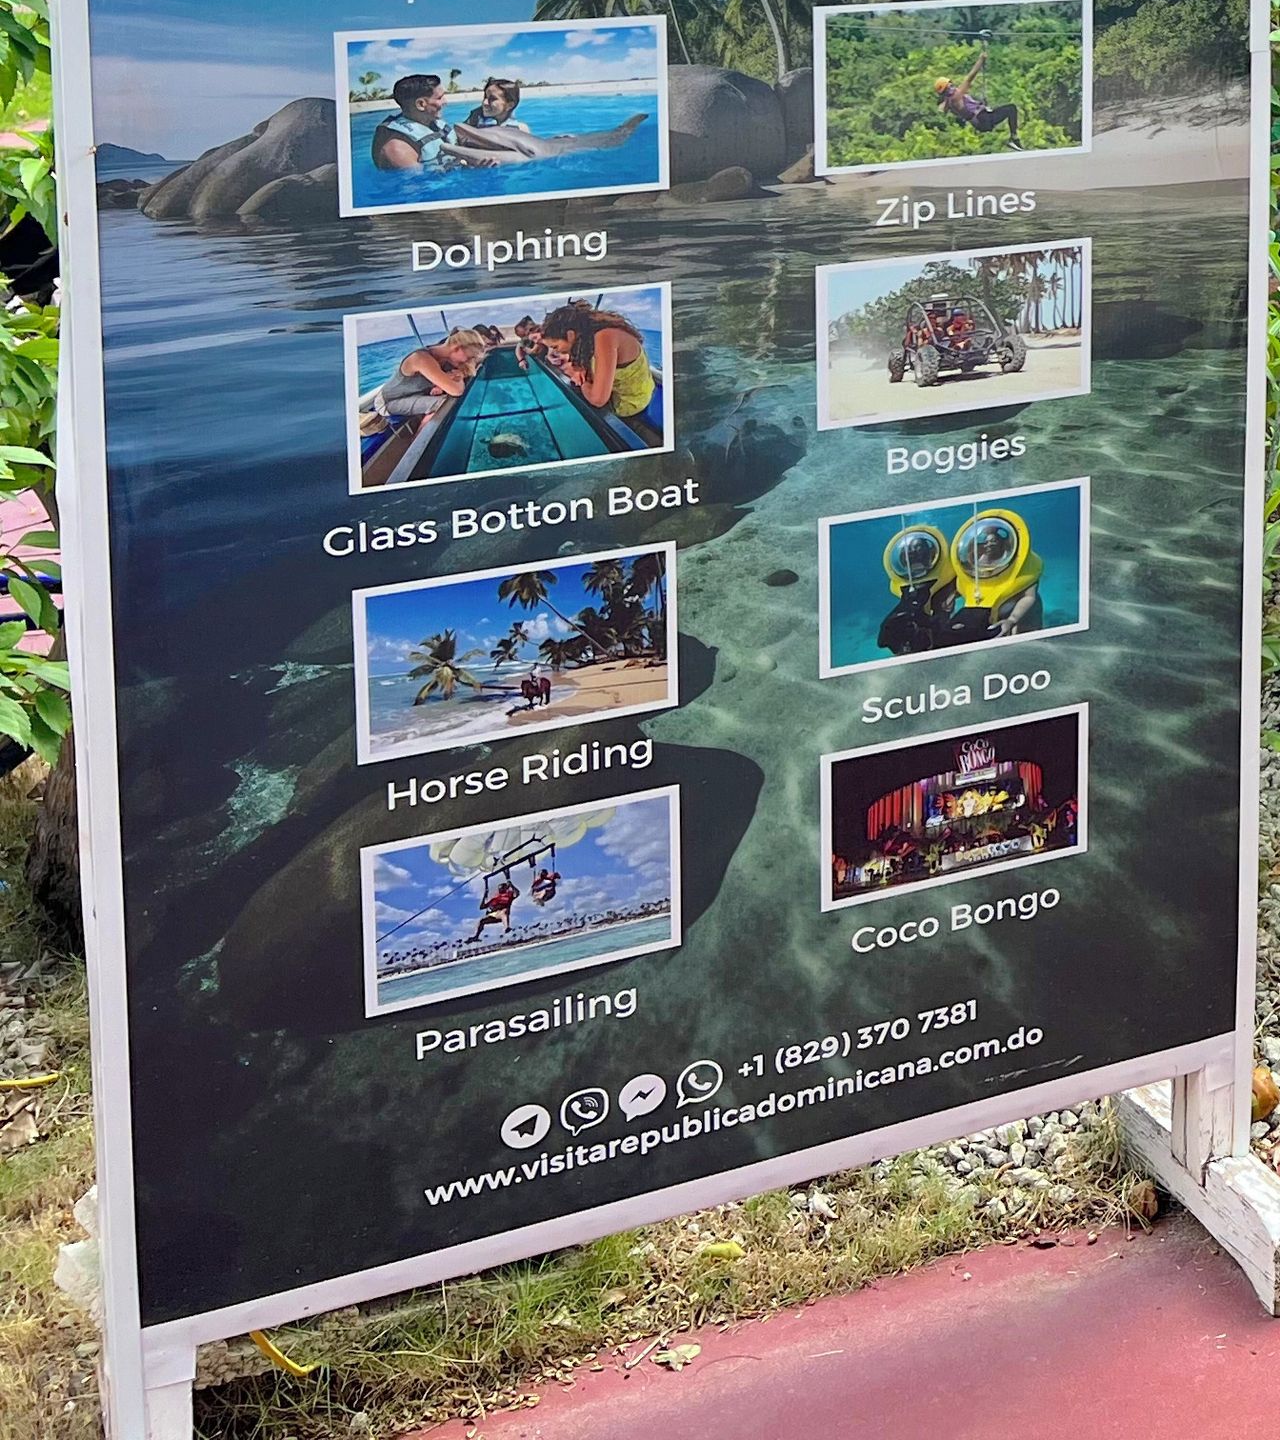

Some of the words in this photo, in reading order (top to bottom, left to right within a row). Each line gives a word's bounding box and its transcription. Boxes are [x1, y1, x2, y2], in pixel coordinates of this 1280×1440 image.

[876, 198, 936, 230] Zip
[947, 191, 1037, 220] Lines
[411, 227, 608, 272] Dolphing
[886, 433, 1027, 477] Boggies
[322, 515, 438, 558] Glass
[450, 498, 594, 539] Botton
[607, 476, 700, 512] Boat
[860, 679, 972, 724] Scuba
[982, 669, 1051, 699] Doo
[387, 764, 509, 811] Horse
[521, 737, 654, 784] Riding
[850, 918, 940, 954] Coco
[950, 885, 1061, 932] Bongo
[415, 986, 637, 1060] Parasailing
[738, 1055, 764, 1079] +1
[774, 1032, 852, 1076] (829)
[857, 1016, 910, 1051] 370
[918, 999, 977, 1035] 7381
[424, 1025, 1045, 1206] www.visitarepublicadominicana.com.do
